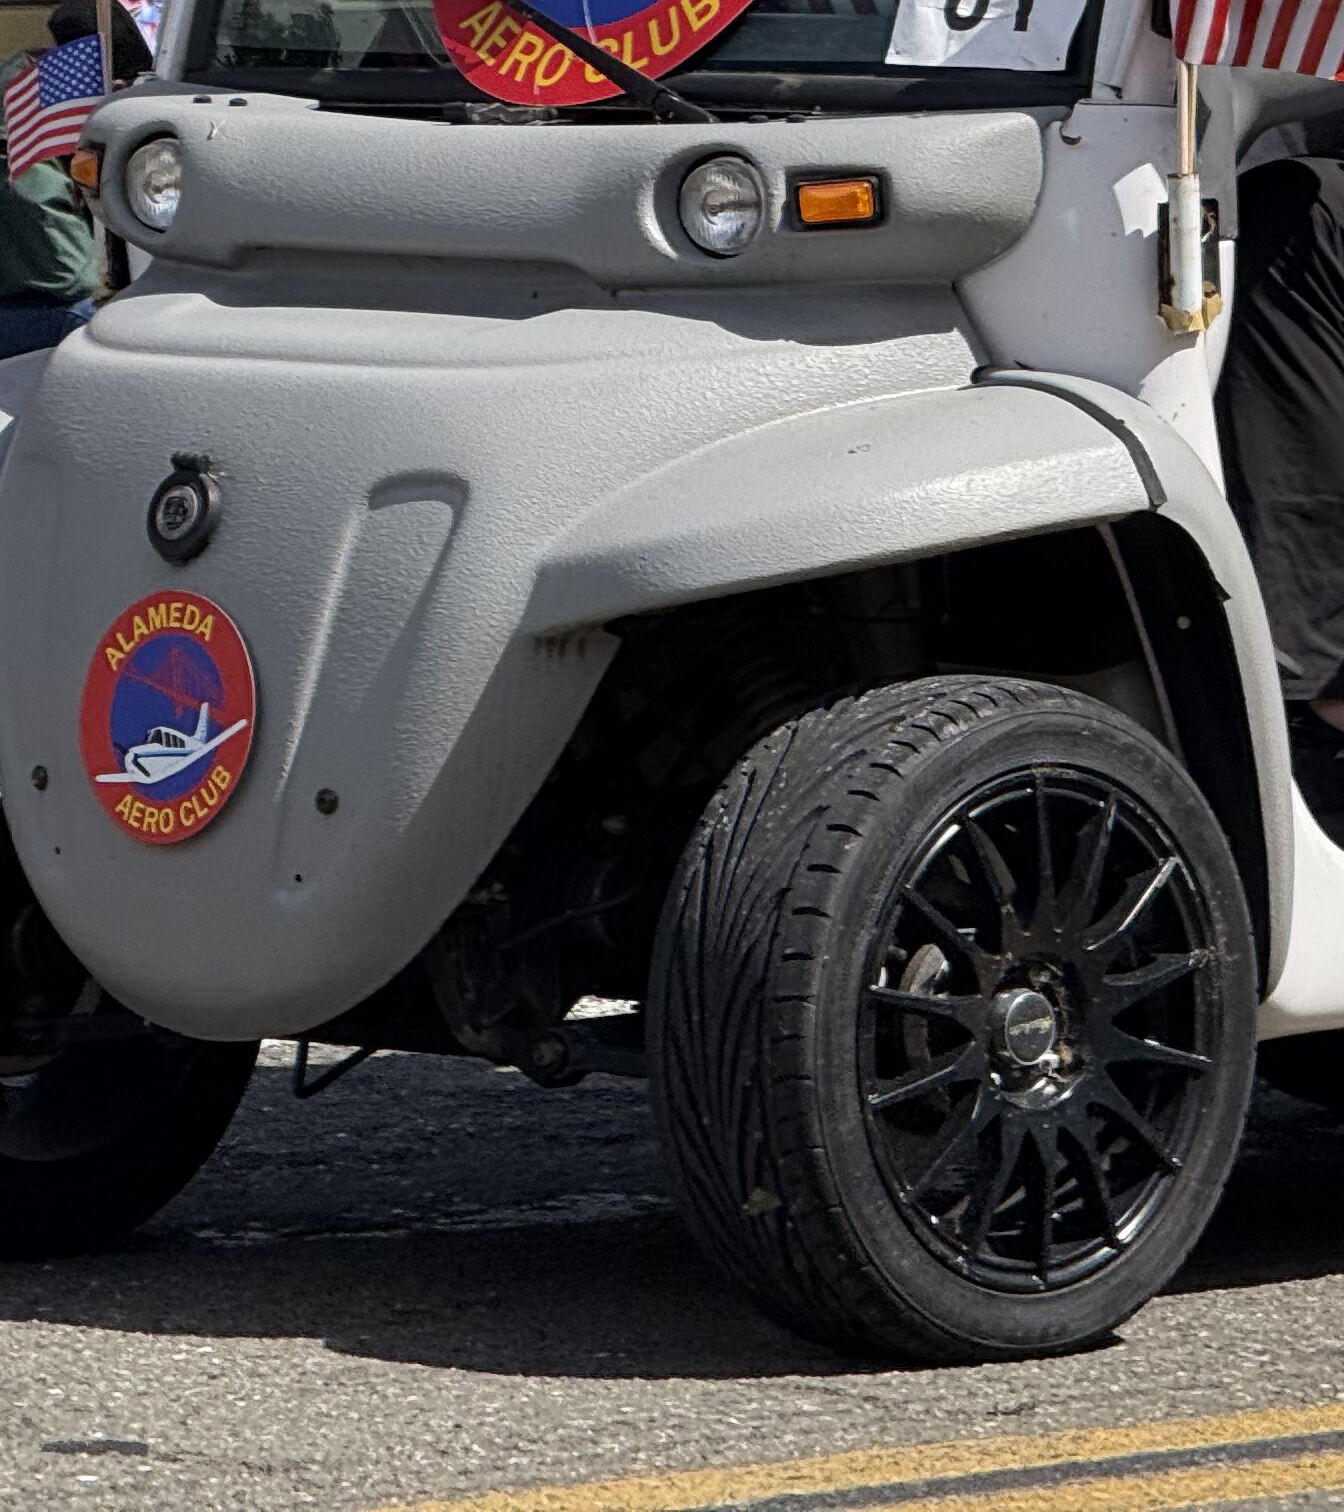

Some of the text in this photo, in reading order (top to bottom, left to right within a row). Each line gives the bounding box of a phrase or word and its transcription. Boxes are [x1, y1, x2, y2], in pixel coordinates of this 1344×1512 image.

[459, 0, 575, 87] AERO
[104, 602, 214, 671] ALAMEDA
[114, 765, 232, 834] AERO CLUB
